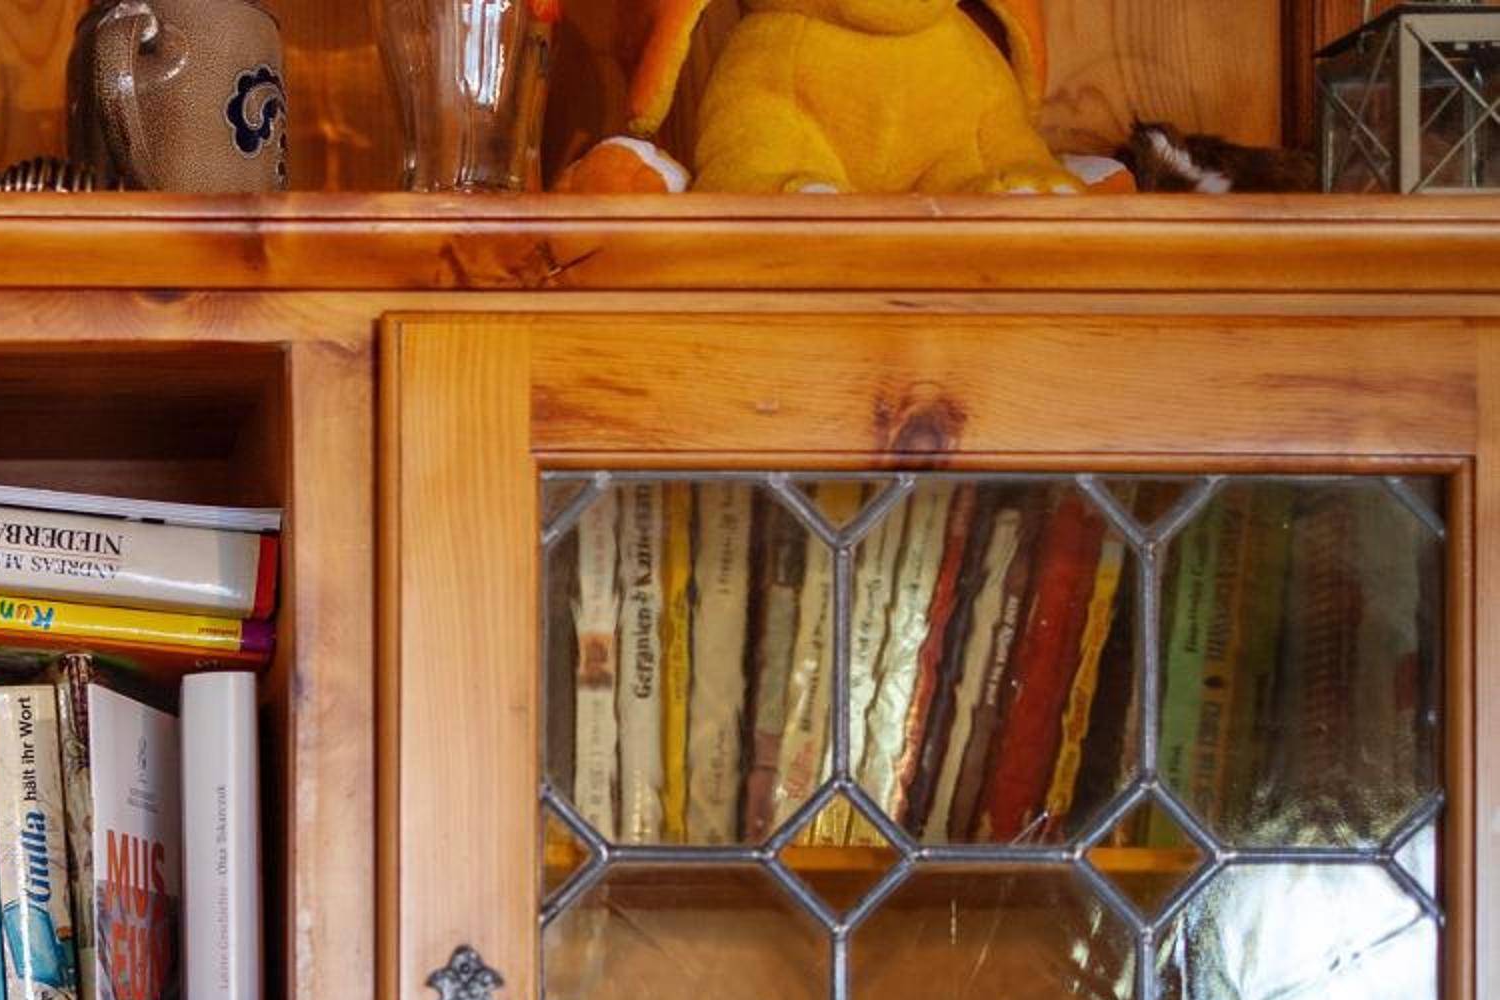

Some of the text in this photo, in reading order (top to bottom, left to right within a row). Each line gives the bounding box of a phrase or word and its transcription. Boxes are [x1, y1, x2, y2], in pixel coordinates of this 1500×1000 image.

[30, 554, 122, 581] ANDREAS
[629, 609, 655, 700] Geranien
[16, 696, 34, 738] Wort
[20, 742, 36, 766] ihr
[21, 769, 39, 801] hält
